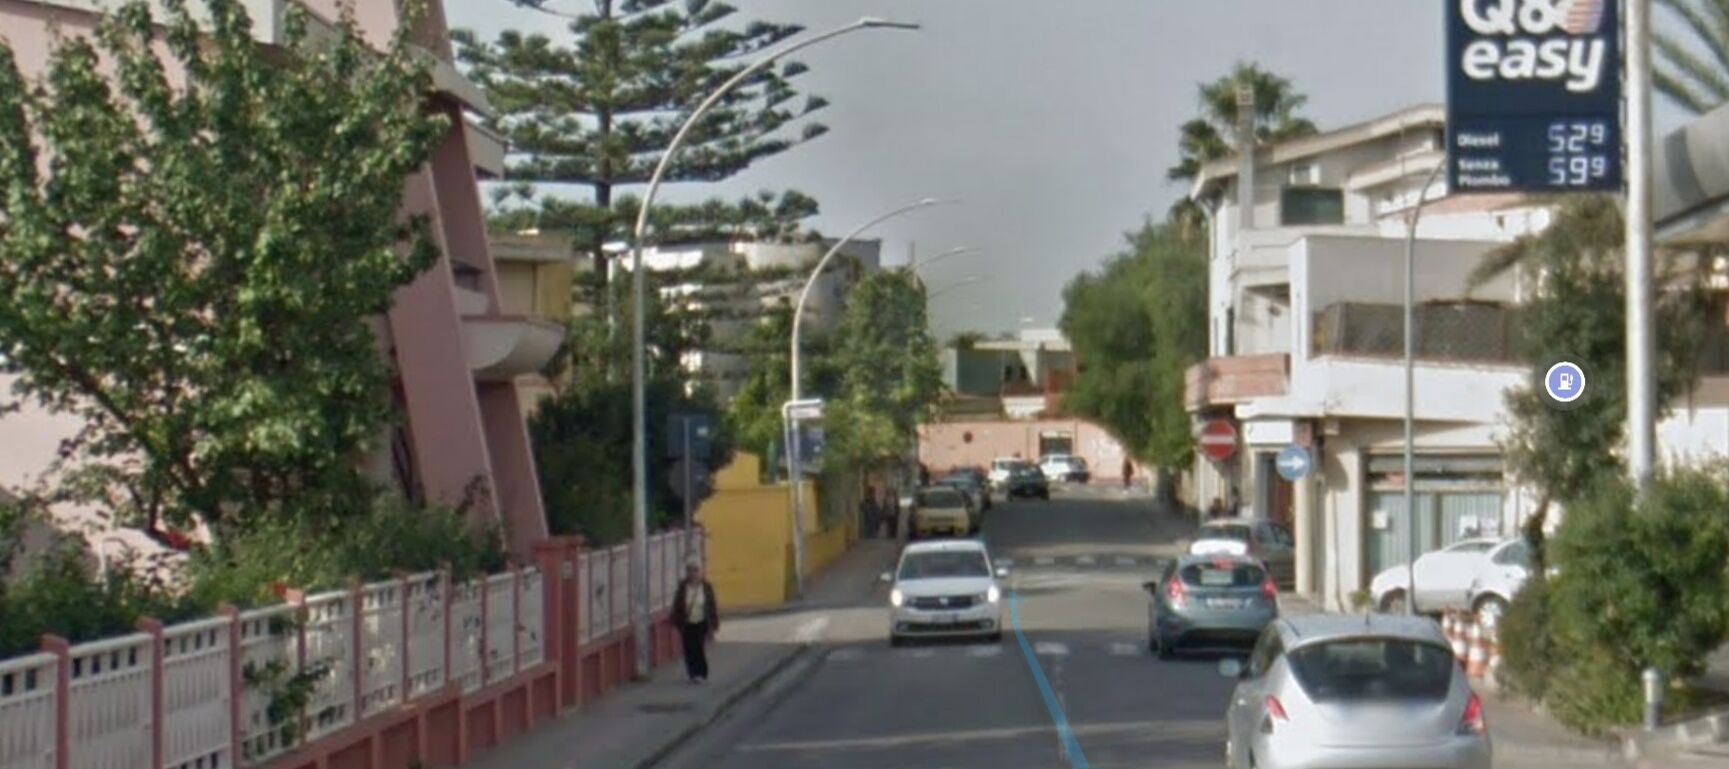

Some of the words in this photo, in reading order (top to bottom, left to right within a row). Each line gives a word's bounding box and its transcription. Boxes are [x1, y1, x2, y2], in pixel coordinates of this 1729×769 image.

[1461, 39, 1605, 91] easy
[1457, 132, 1500, 147] Diesel
[1458, 159, 1500, 170] Senza
